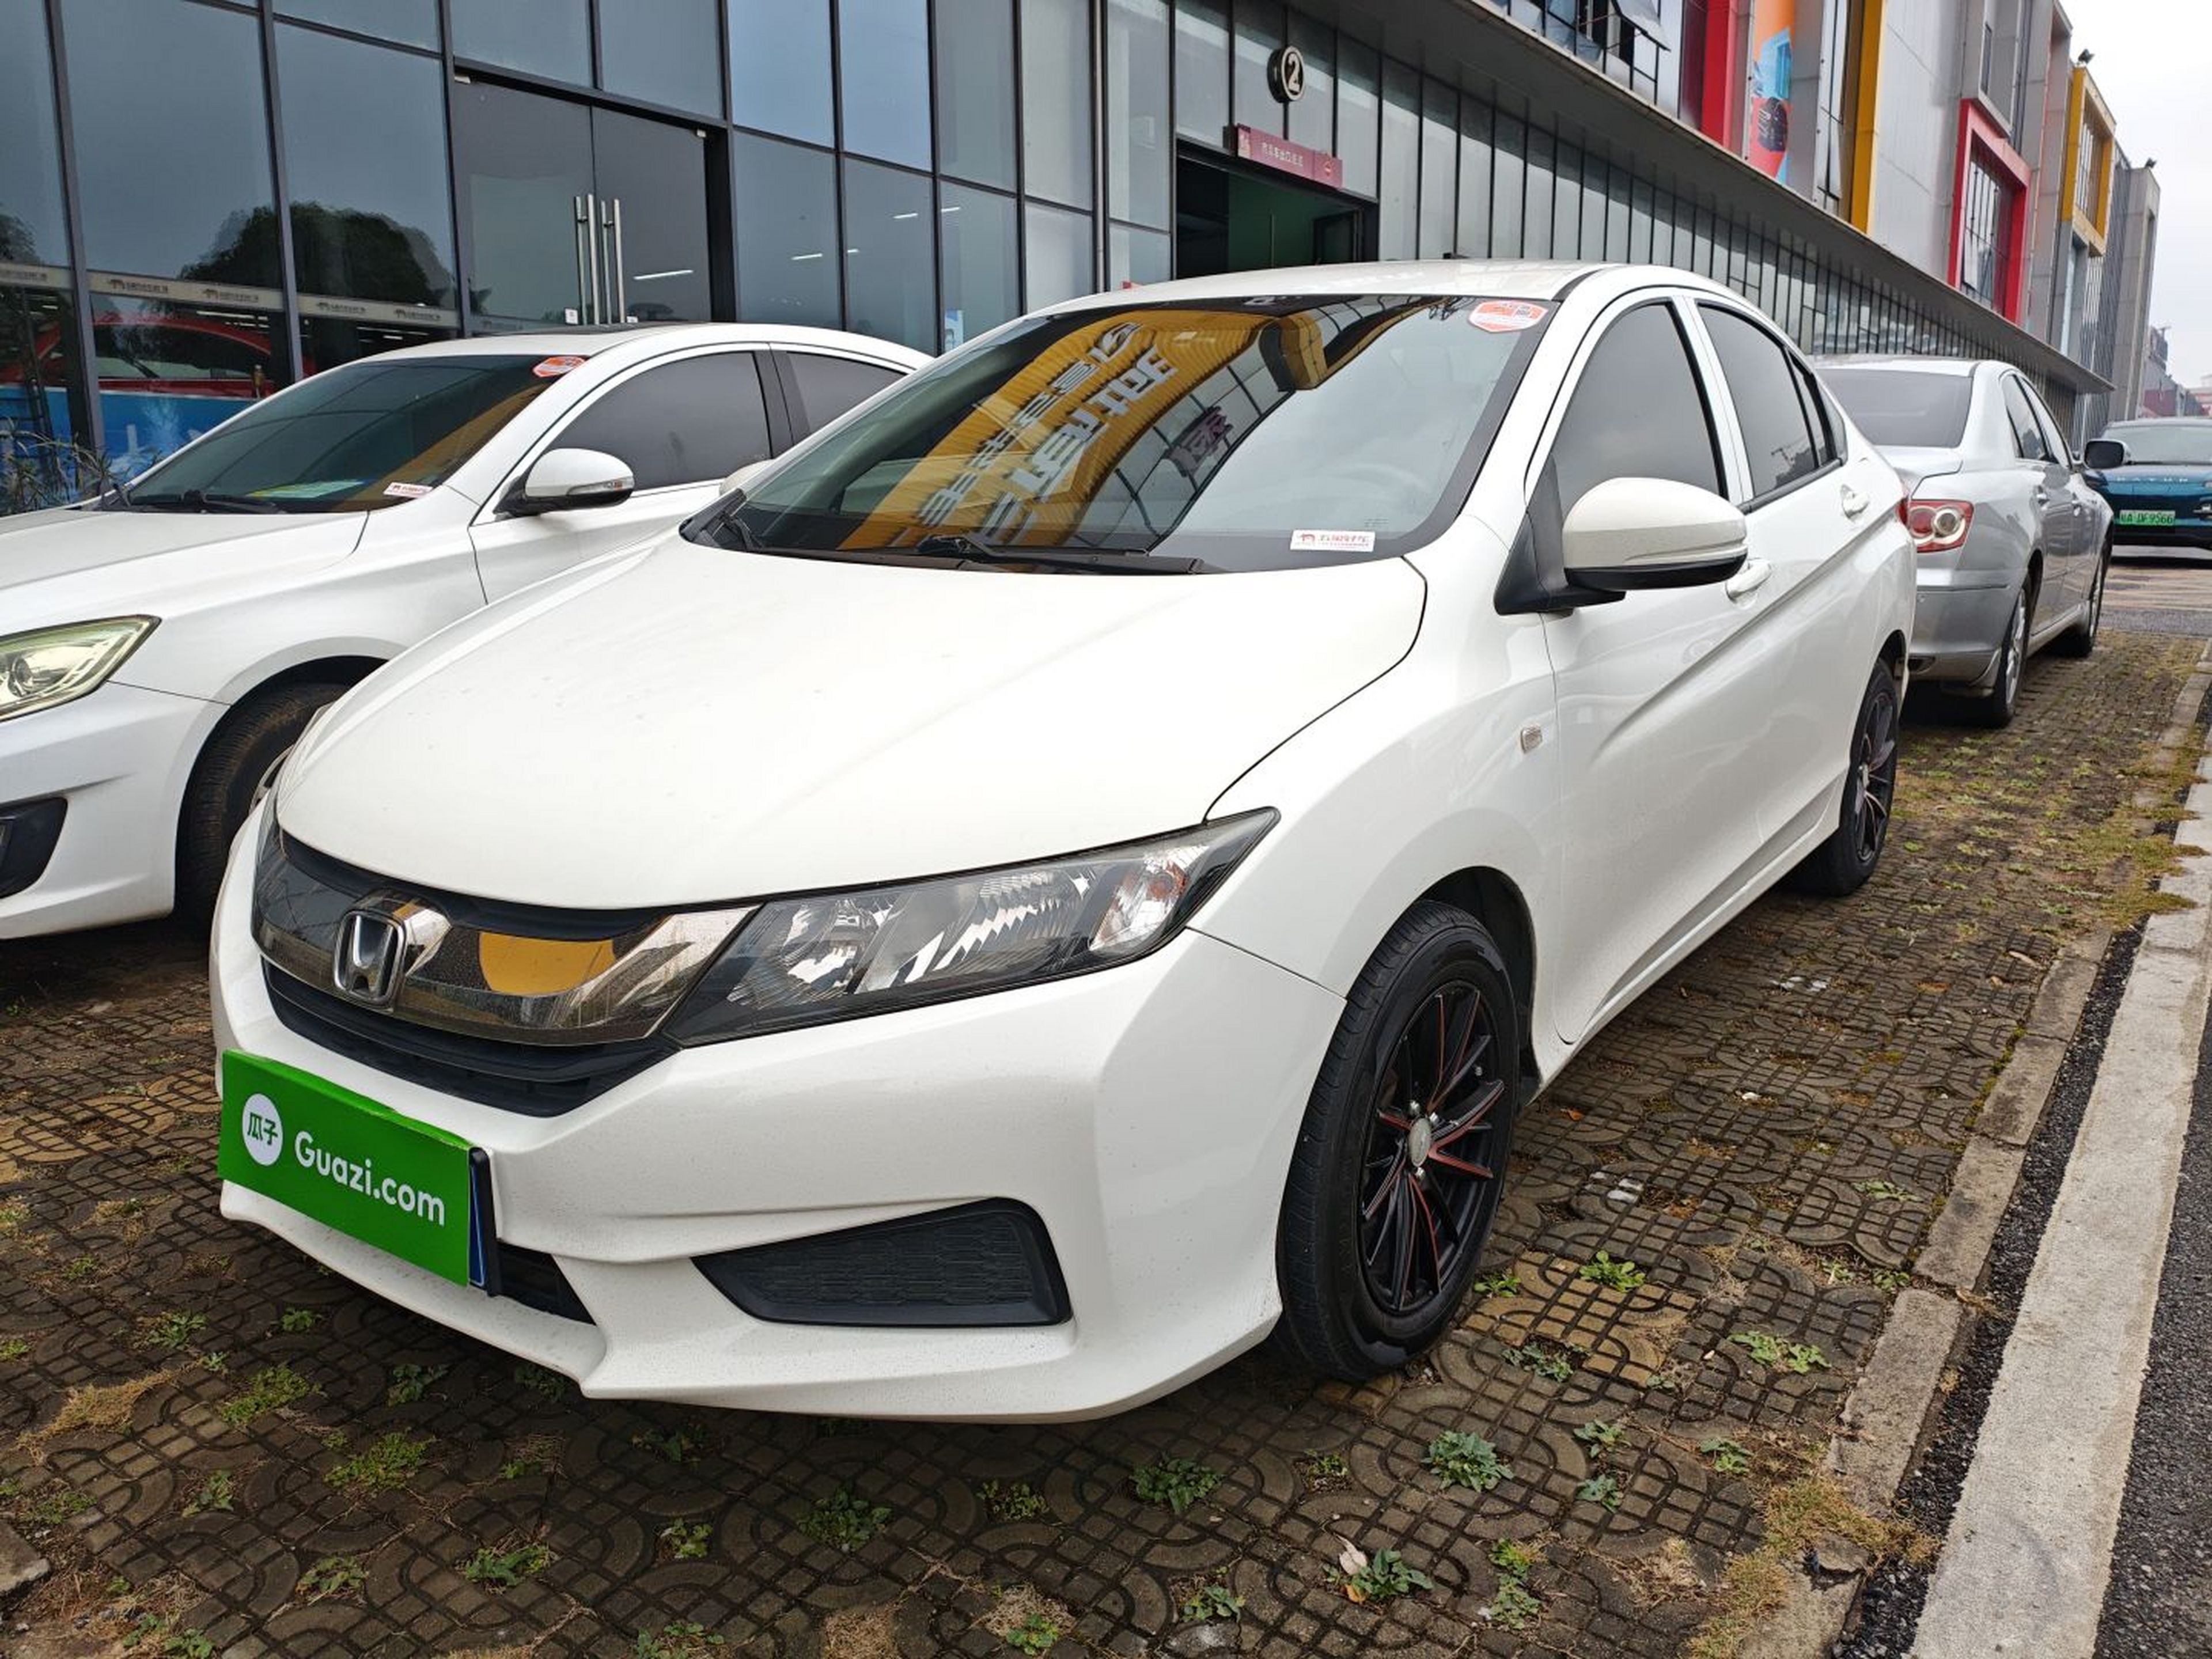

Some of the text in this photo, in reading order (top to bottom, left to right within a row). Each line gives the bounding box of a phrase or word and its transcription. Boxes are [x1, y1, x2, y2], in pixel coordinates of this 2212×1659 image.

[1287, 53, 1300, 92] 2
[247, 1112, 278, 1146] 瓜子
[294, 1130, 445, 1226] Guazi.com
